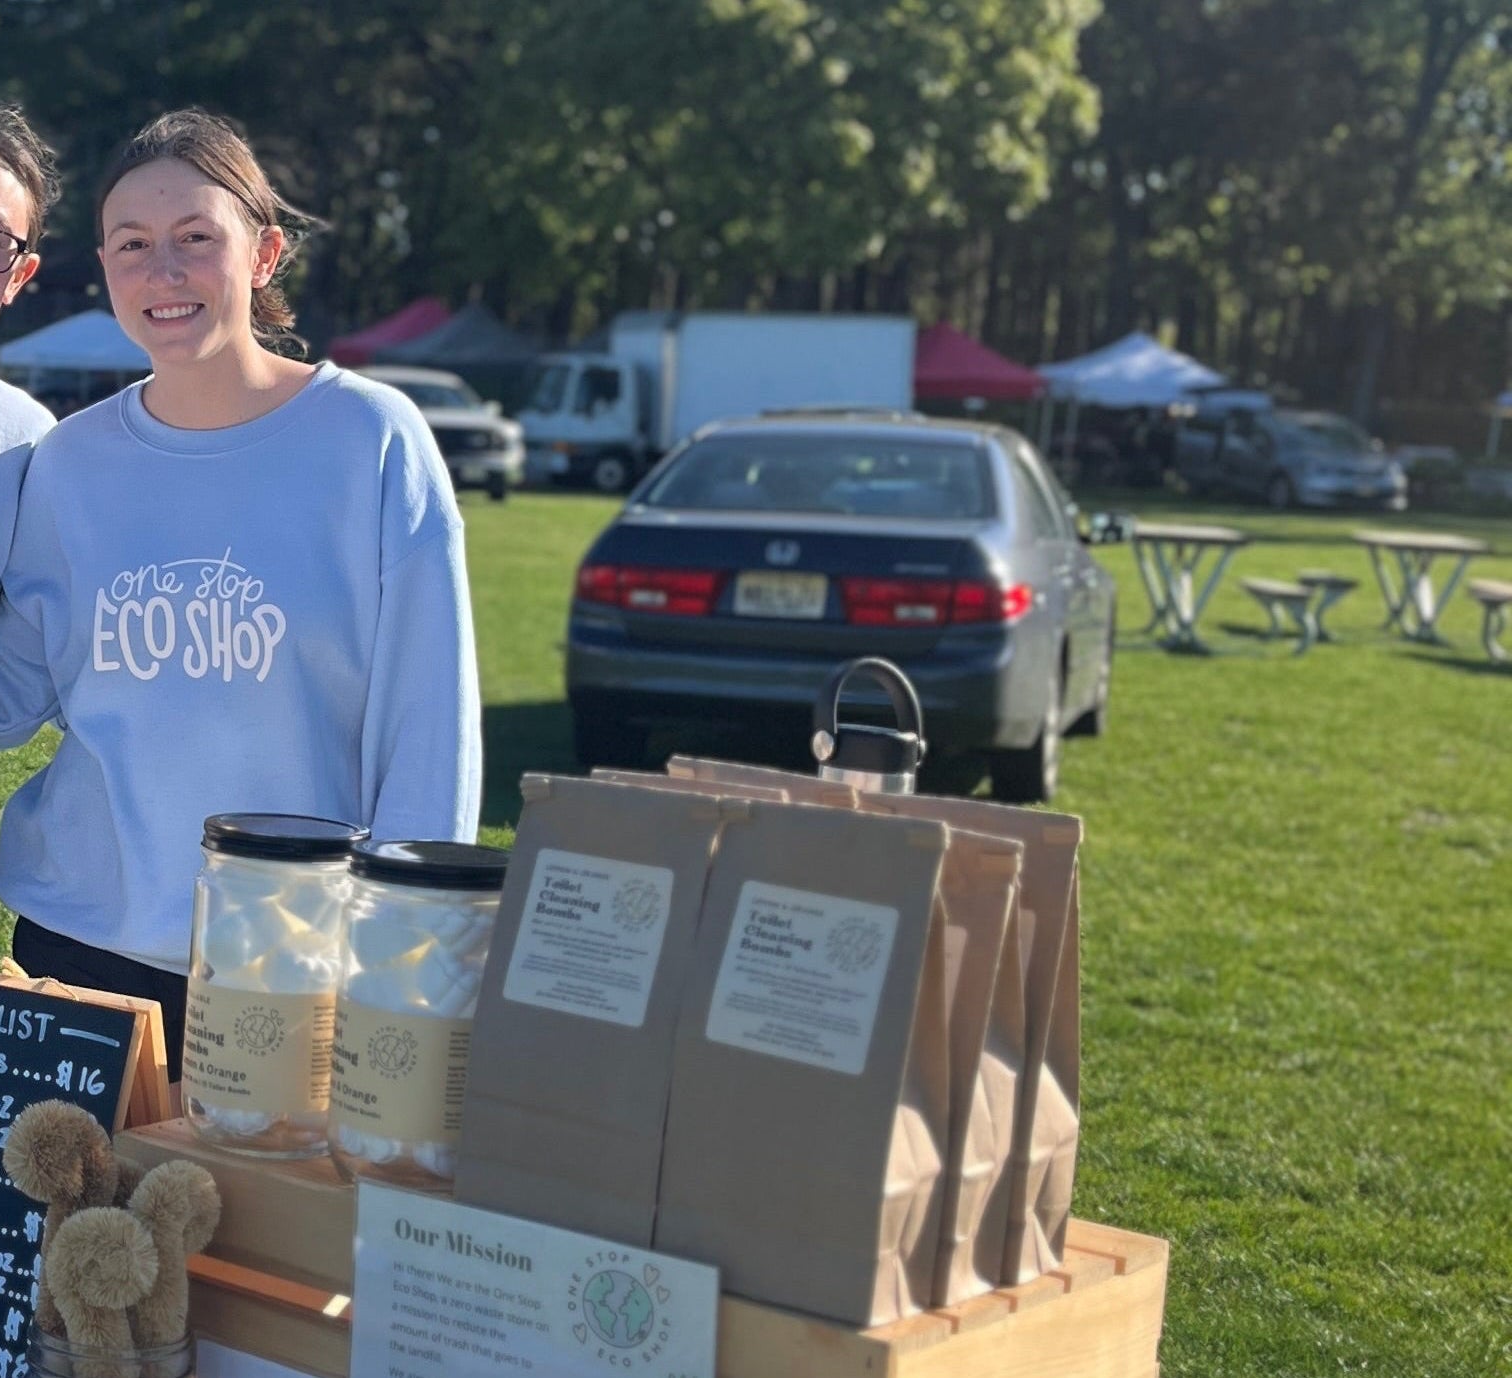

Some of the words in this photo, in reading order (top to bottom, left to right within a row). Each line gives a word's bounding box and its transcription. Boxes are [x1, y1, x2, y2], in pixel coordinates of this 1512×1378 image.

[110, 562, 184, 601] one
[173, 545, 265, 615] stop
[92, 588, 176, 681] ECO
[183, 599, 287, 682] SHOP
[543, 876, 583, 894] Toilet
[536, 902, 582, 921] Bombs
[539, 890, 601, 914] Cleaning
[749, 910, 792, 929] Toilet
[740, 938, 792, 959] Bombs
[744, 925, 813, 951] Cleaning
[207, 1064, 247, 1083] Orange
[395, 1217, 440, 1248] Our
[445, 1229, 533, 1274] Mission
[585, 1251, 630, 1268] STOP
[393, 1260, 405, 1273] Hi
[436, 1272, 453, 1287] We
[455, 1279, 473, 1291] are
[474, 1282, 491, 1298] the
[493, 1287, 515, 1302] One
[517, 1294, 543, 1311] Stop
[567, 1271, 582, 1312] ONE
[393, 1279, 411, 1295] Eco
[440, 1296, 448, 1305] a
[450, 1298, 473, 1312] zero
[474, 1305, 505, 1321] waste
[506, 1312, 535, 1328] store
[535, 1321, 551, 1334] on
[391, 1301, 399, 1311] a
[400, 1303, 438, 1321] mission
[439, 1313, 450, 1326] to
[452, 1318, 488, 1335] reduce
[489, 1326, 507, 1342] the
[389, 1321, 429, 1340] amount
[431, 1331, 442, 1344] of
[443, 1334, 470, 1352] trash
[471, 1342, 492, 1358] that
[494, 1350, 520, 1366] goes
[520, 1356, 534, 1370] to
[389, 1339, 406, 1354] the
[641, 1317, 672, 1364] SHOP
[597, 1347, 633, 1368] ECO
